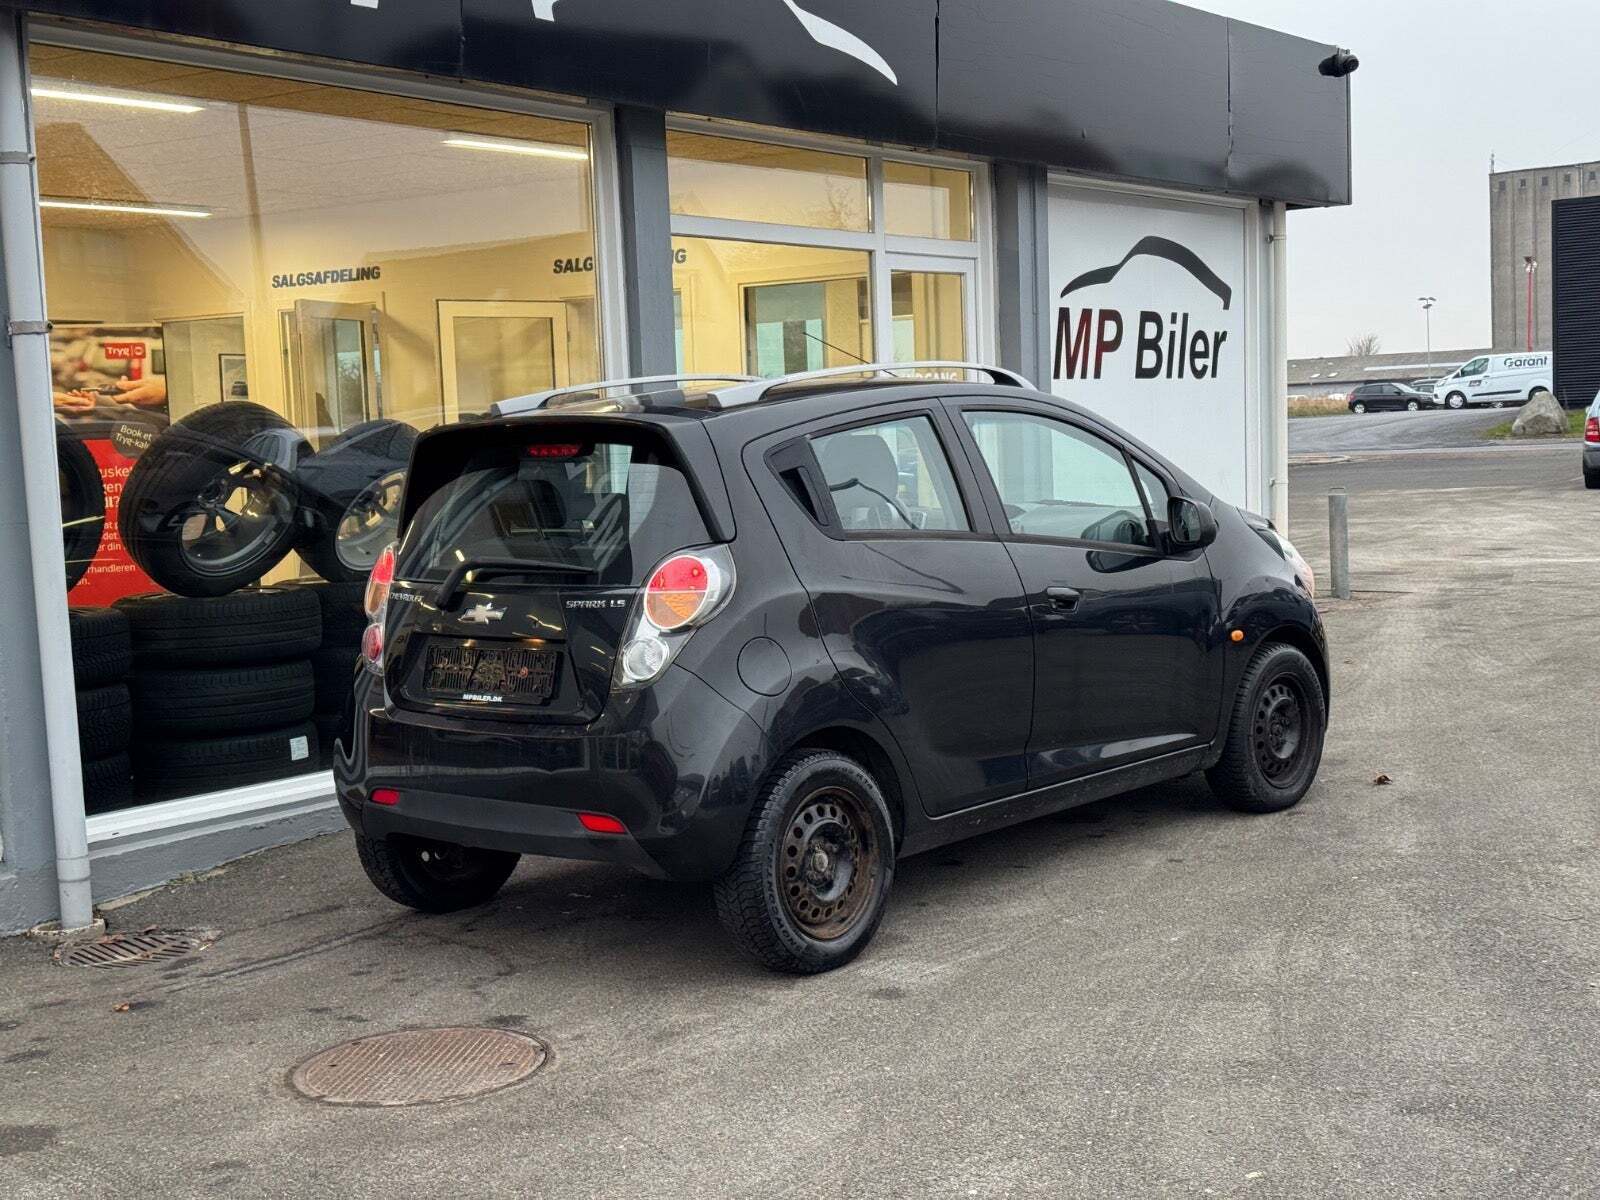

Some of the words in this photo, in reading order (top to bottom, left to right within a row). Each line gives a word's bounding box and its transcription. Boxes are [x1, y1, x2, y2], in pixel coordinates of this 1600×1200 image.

[271, 266, 381, 288] SALGSAFDELING
[1053, 307, 1123, 379] MP
[1135, 311, 1227, 379] Biler
[106, 346, 130, 357] Tryg
[1504, 356, 1547, 367] Garant
[120, 425, 142, 438] Book
[565, 600, 606, 609] SPARK
[610, 599, 626, 608] LS
